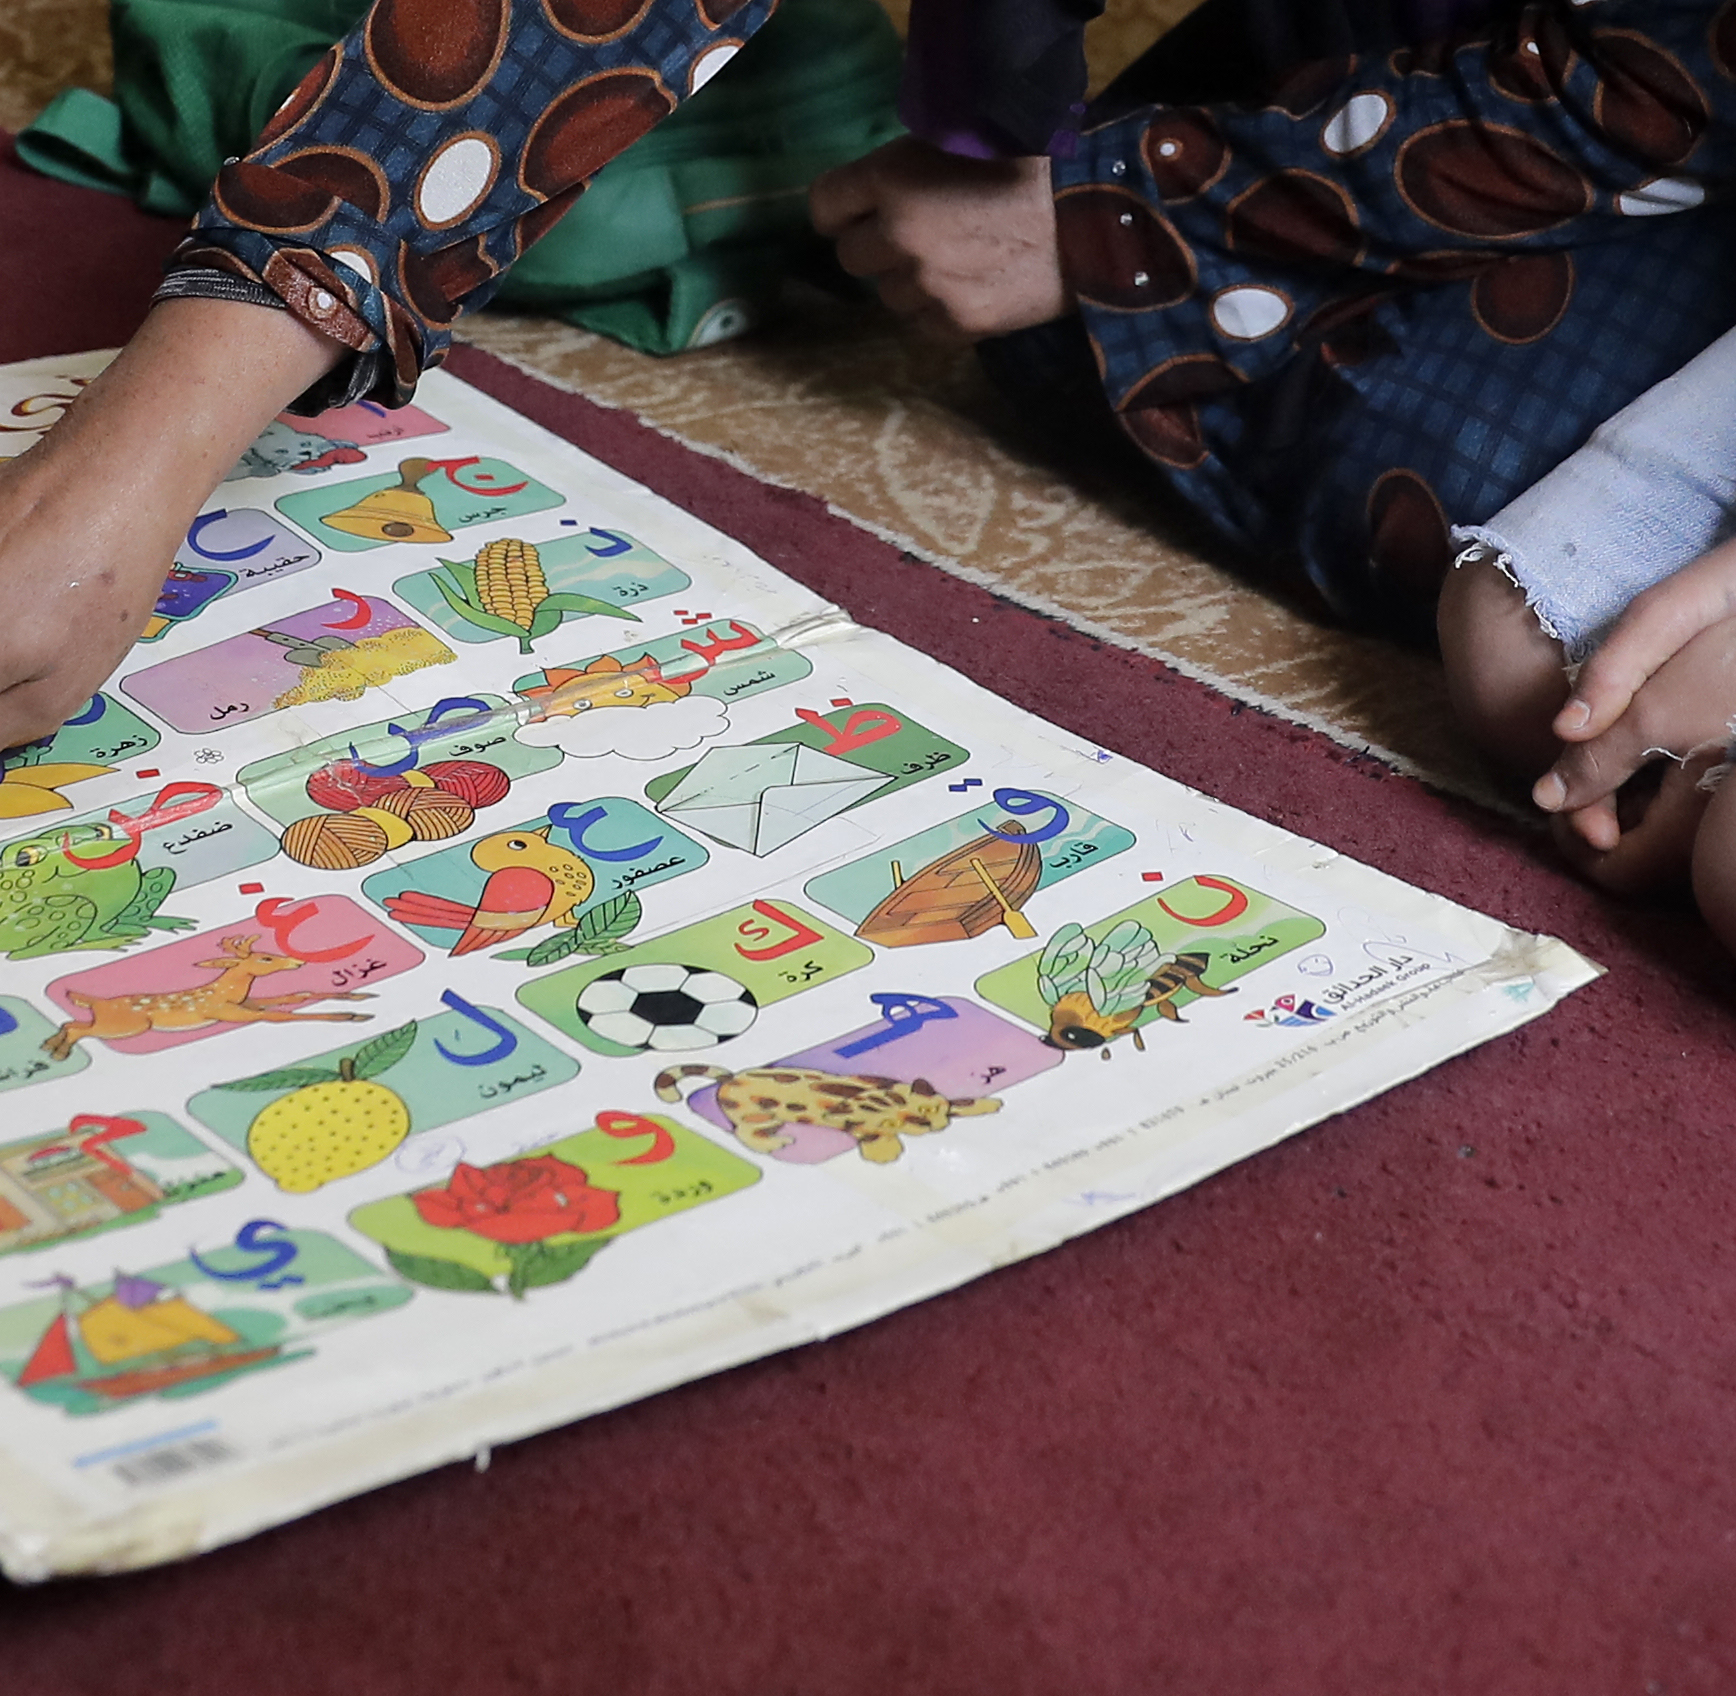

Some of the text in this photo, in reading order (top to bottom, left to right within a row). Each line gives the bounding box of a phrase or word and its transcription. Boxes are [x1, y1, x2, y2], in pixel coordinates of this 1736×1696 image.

[425, 456, 529, 497] ج
[458, 505, 508, 523] جرس
[559, 519, 633, 558] ذ
[238, 554, 311, 579] حقيبة
[321, 588, 372, 630] ر
[614, 581, 648, 599] ذرة
[721, 670, 776, 696] شمس
[209, 702, 250, 721] رمل
[795, 697, 903, 756] ظ
[89, 734, 148, 759] زهرة
[447, 733, 508, 757] صوف
[900, 749, 953, 776] ظرف
[61, 768, 224, 871] ض
[948, 778, 1070, 845] ق
[162, 820, 234, 856] ضفدع
[547, 801, 664, 862] ع
[609, 854, 687, 890] عصفور
[1050, 840, 1100, 870] قارب
[1141, 871, 1250, 927] ن
[238, 882, 378, 964] غ
[733, 898, 826, 962] ك
[1219, 934, 1281, 965] نحلة
[329, 955, 390, 988] غزال
[777, 960, 825, 985] كرة
[1322, 954, 1413, 1004] دار الحدائق
[1395, 962, 1431, 982] Group
[433, 988, 518, 1067] ل
[476, 1062, 548, 1100] ليمون
[67, 1112, 148, 1176] م
[594, 1110, 676, 1166] و
[189, 1219, 305, 1290] ي
